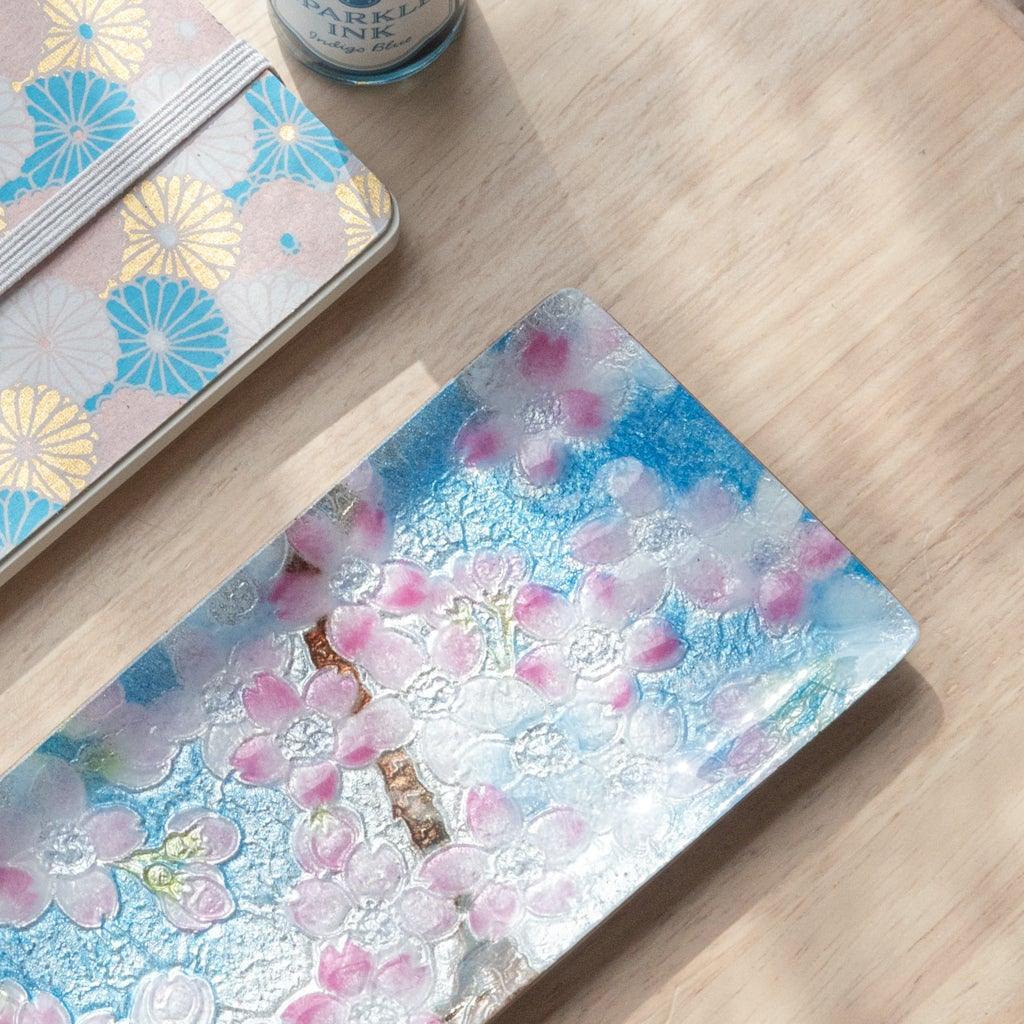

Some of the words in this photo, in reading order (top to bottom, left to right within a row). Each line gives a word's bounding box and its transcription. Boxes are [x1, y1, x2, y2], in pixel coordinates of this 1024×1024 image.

[328, 23, 395, 39] INK
[309, 31, 365, 54] Indigo
[372, 36, 413, 52] Blue
